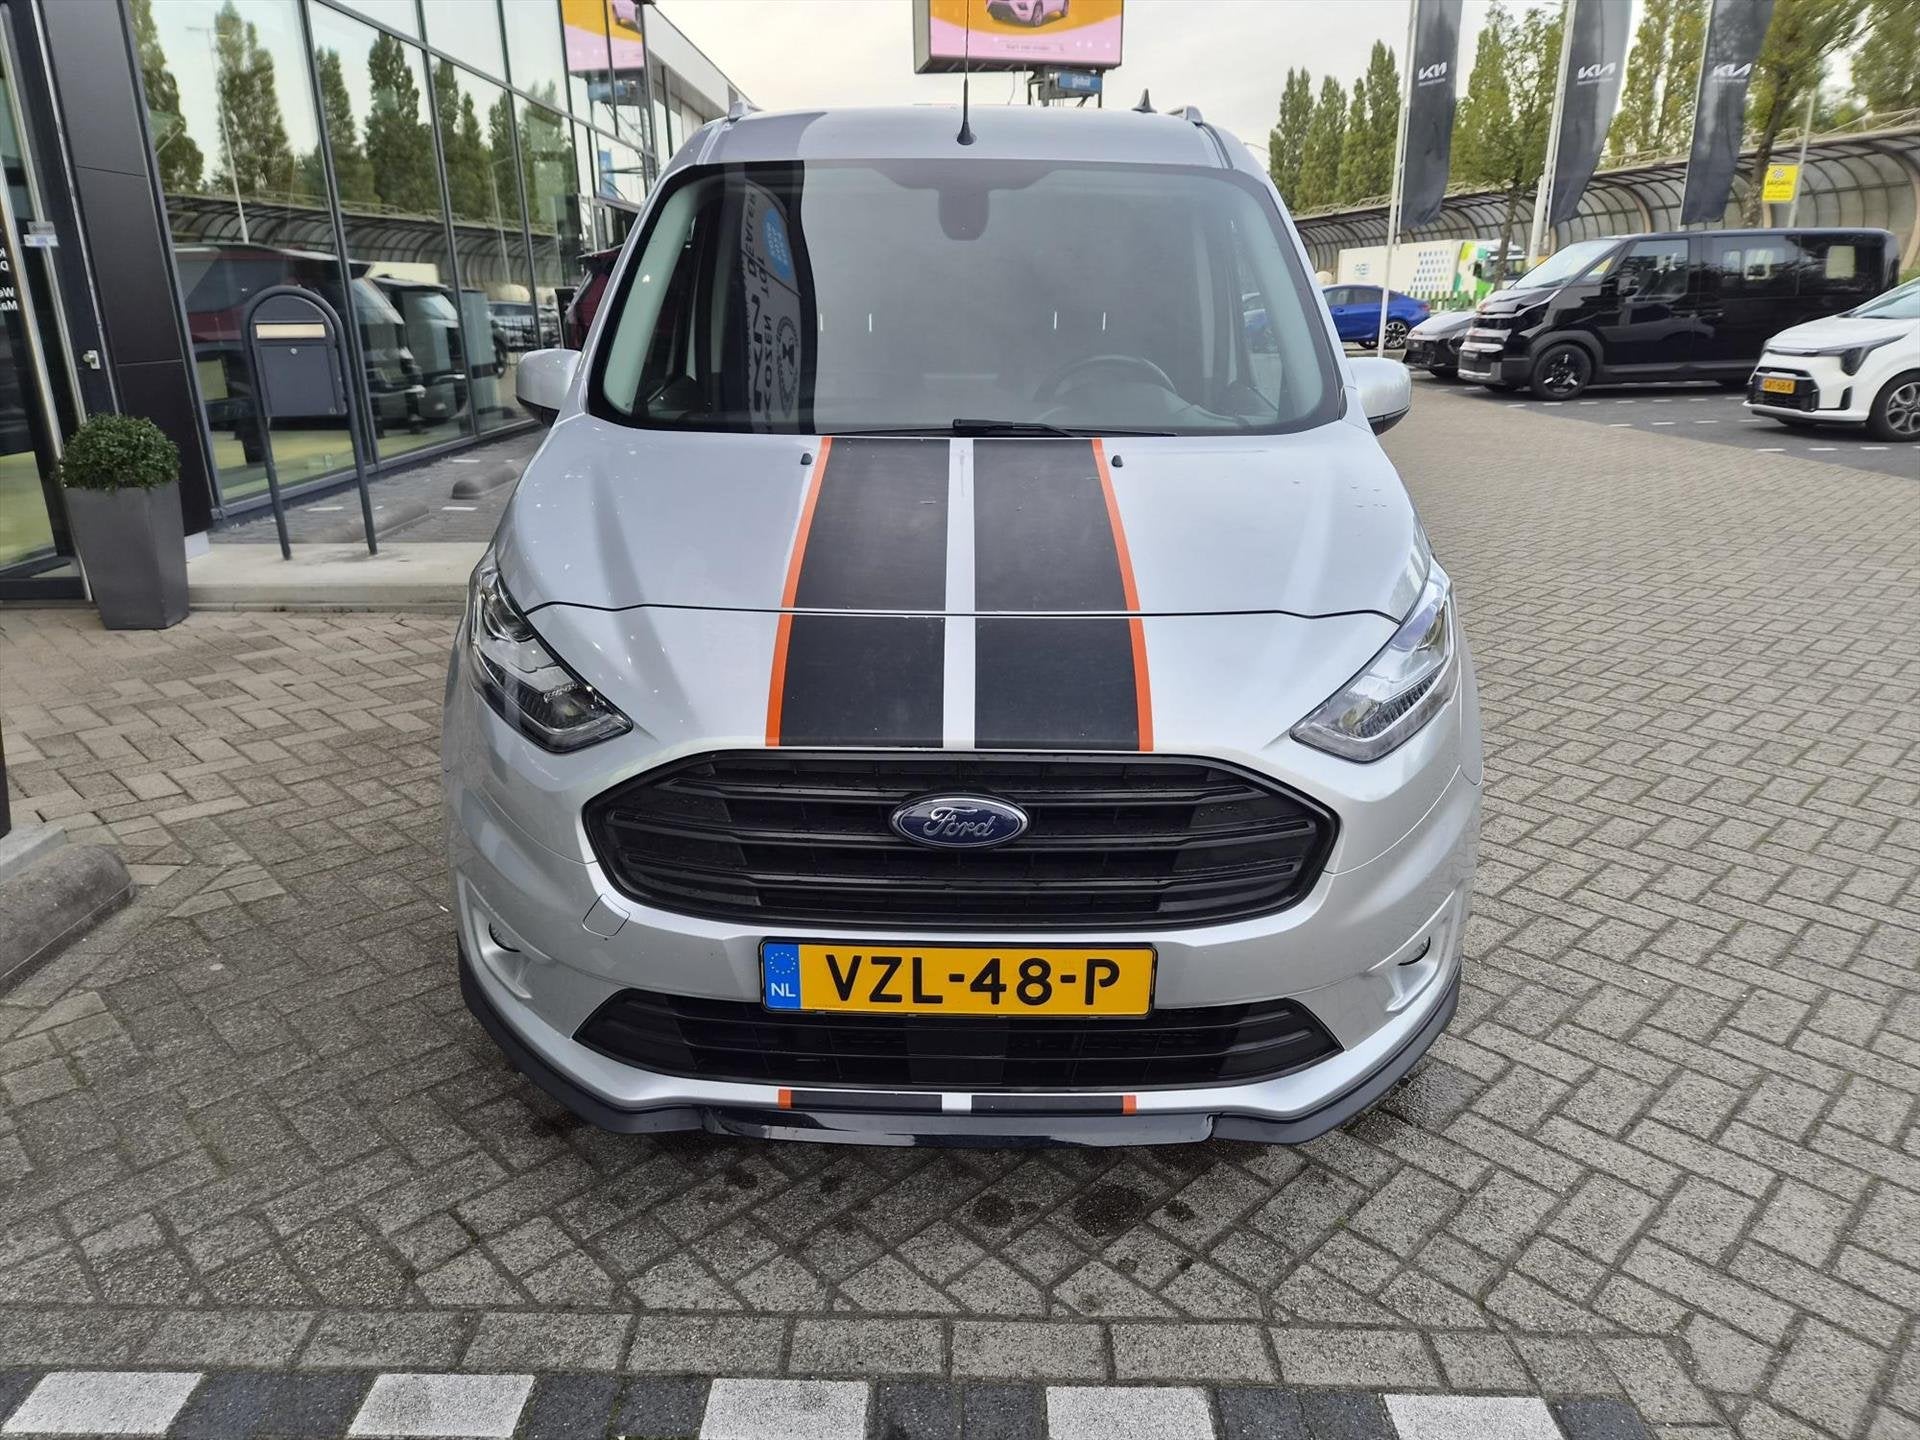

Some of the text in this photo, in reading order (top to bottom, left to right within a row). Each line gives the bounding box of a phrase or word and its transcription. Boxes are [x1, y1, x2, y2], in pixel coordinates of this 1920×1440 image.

[922, 806, 996, 838] Ford
[771, 982, 796, 998] NL
[825, 954, 1120, 1006] VZL-48-P
